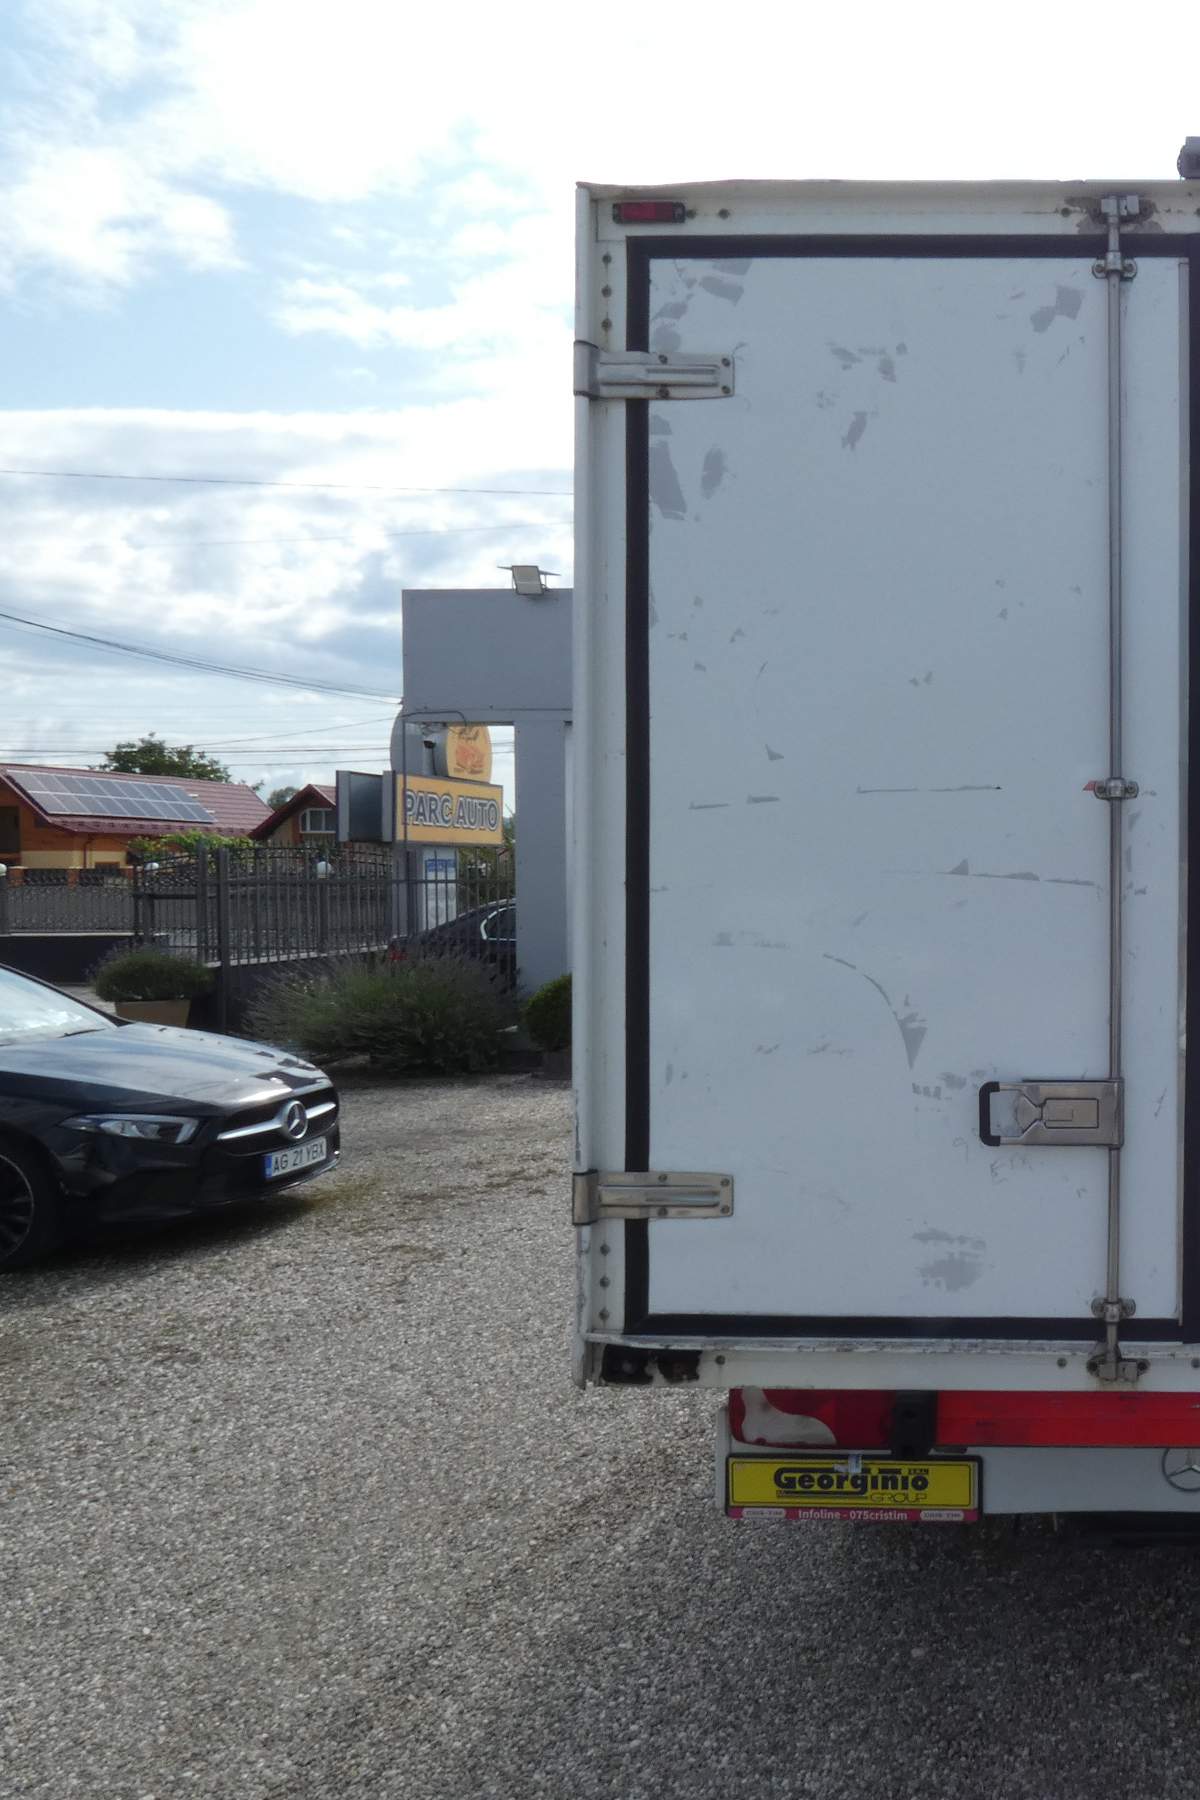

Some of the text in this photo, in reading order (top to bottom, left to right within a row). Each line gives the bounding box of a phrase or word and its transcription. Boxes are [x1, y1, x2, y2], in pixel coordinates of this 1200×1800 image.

[404, 789, 499, 832] PARC AUTO
[273, 1141, 325, 1174] AG 21 YBX
[870, 1492, 928, 1503] GROUP
[799, 1509, 841, 1520] Infoline
